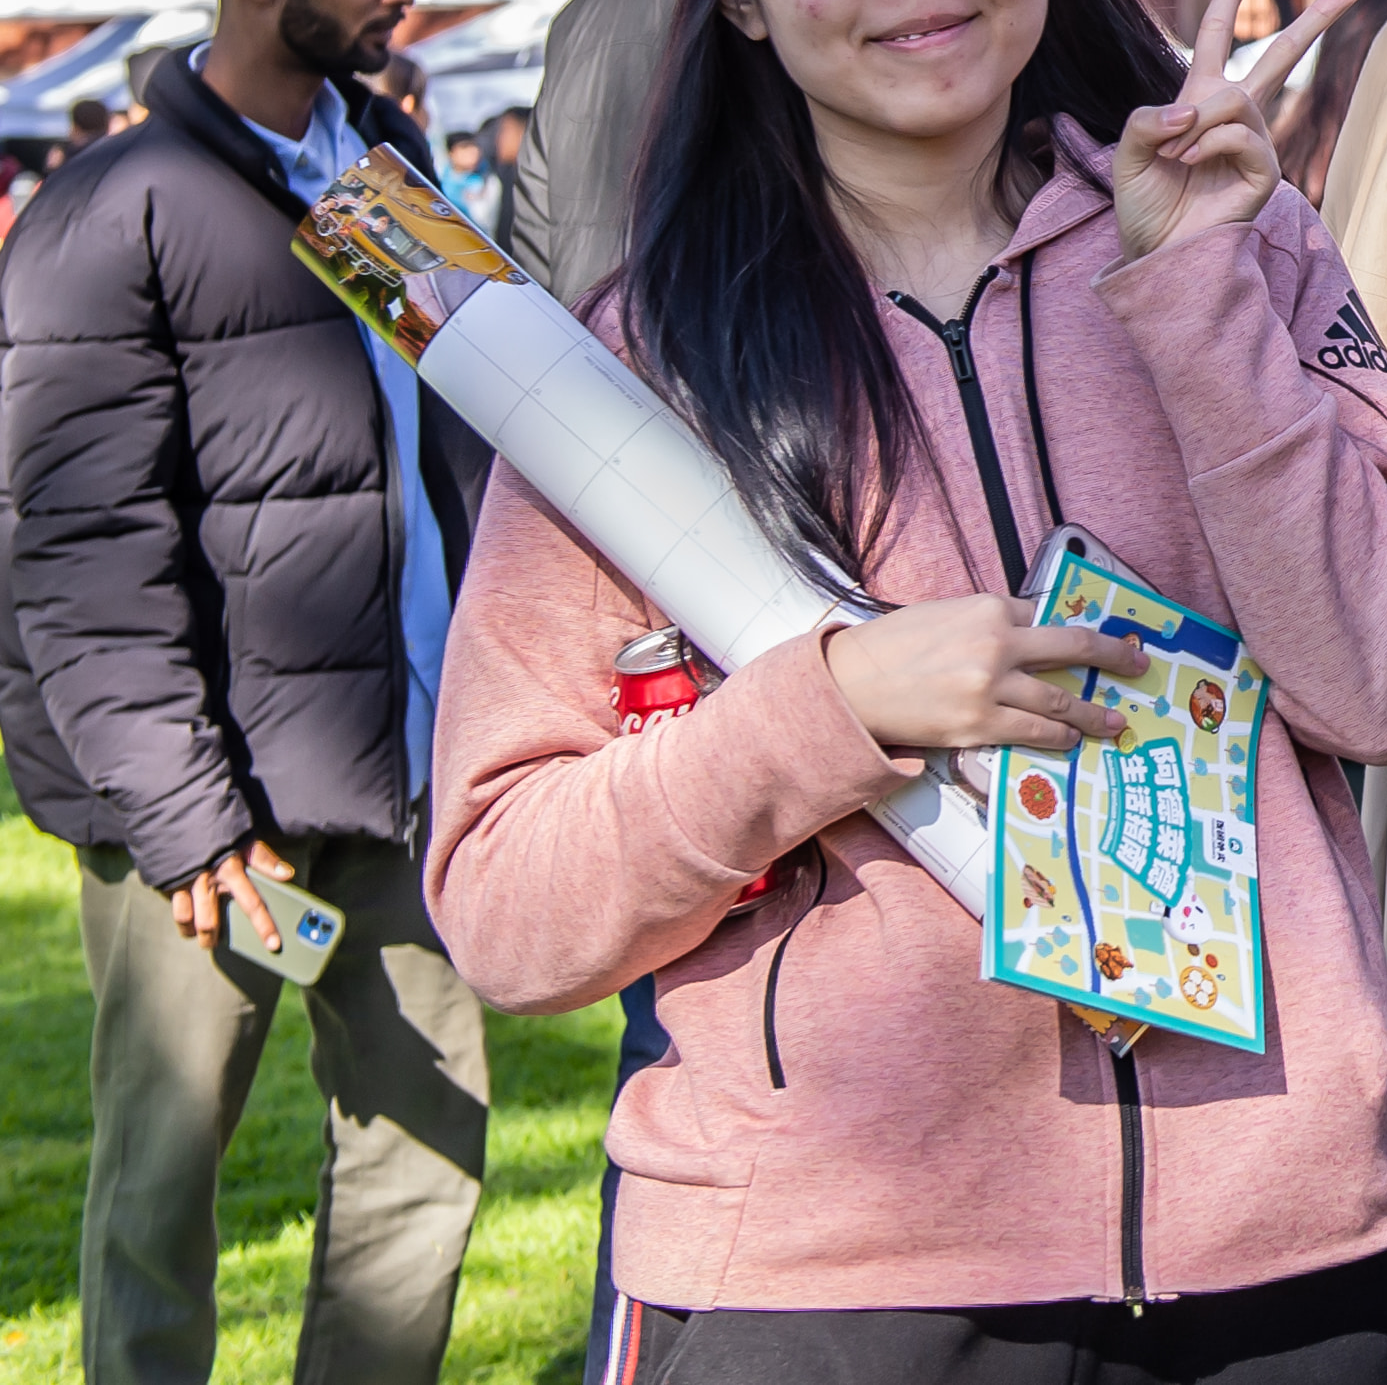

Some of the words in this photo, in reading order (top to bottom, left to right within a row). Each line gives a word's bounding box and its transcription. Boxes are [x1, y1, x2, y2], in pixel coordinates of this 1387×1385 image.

[1115, 753, 1153, 875] 生活指南
[1146, 745, 1186, 900] 阿德莱德
